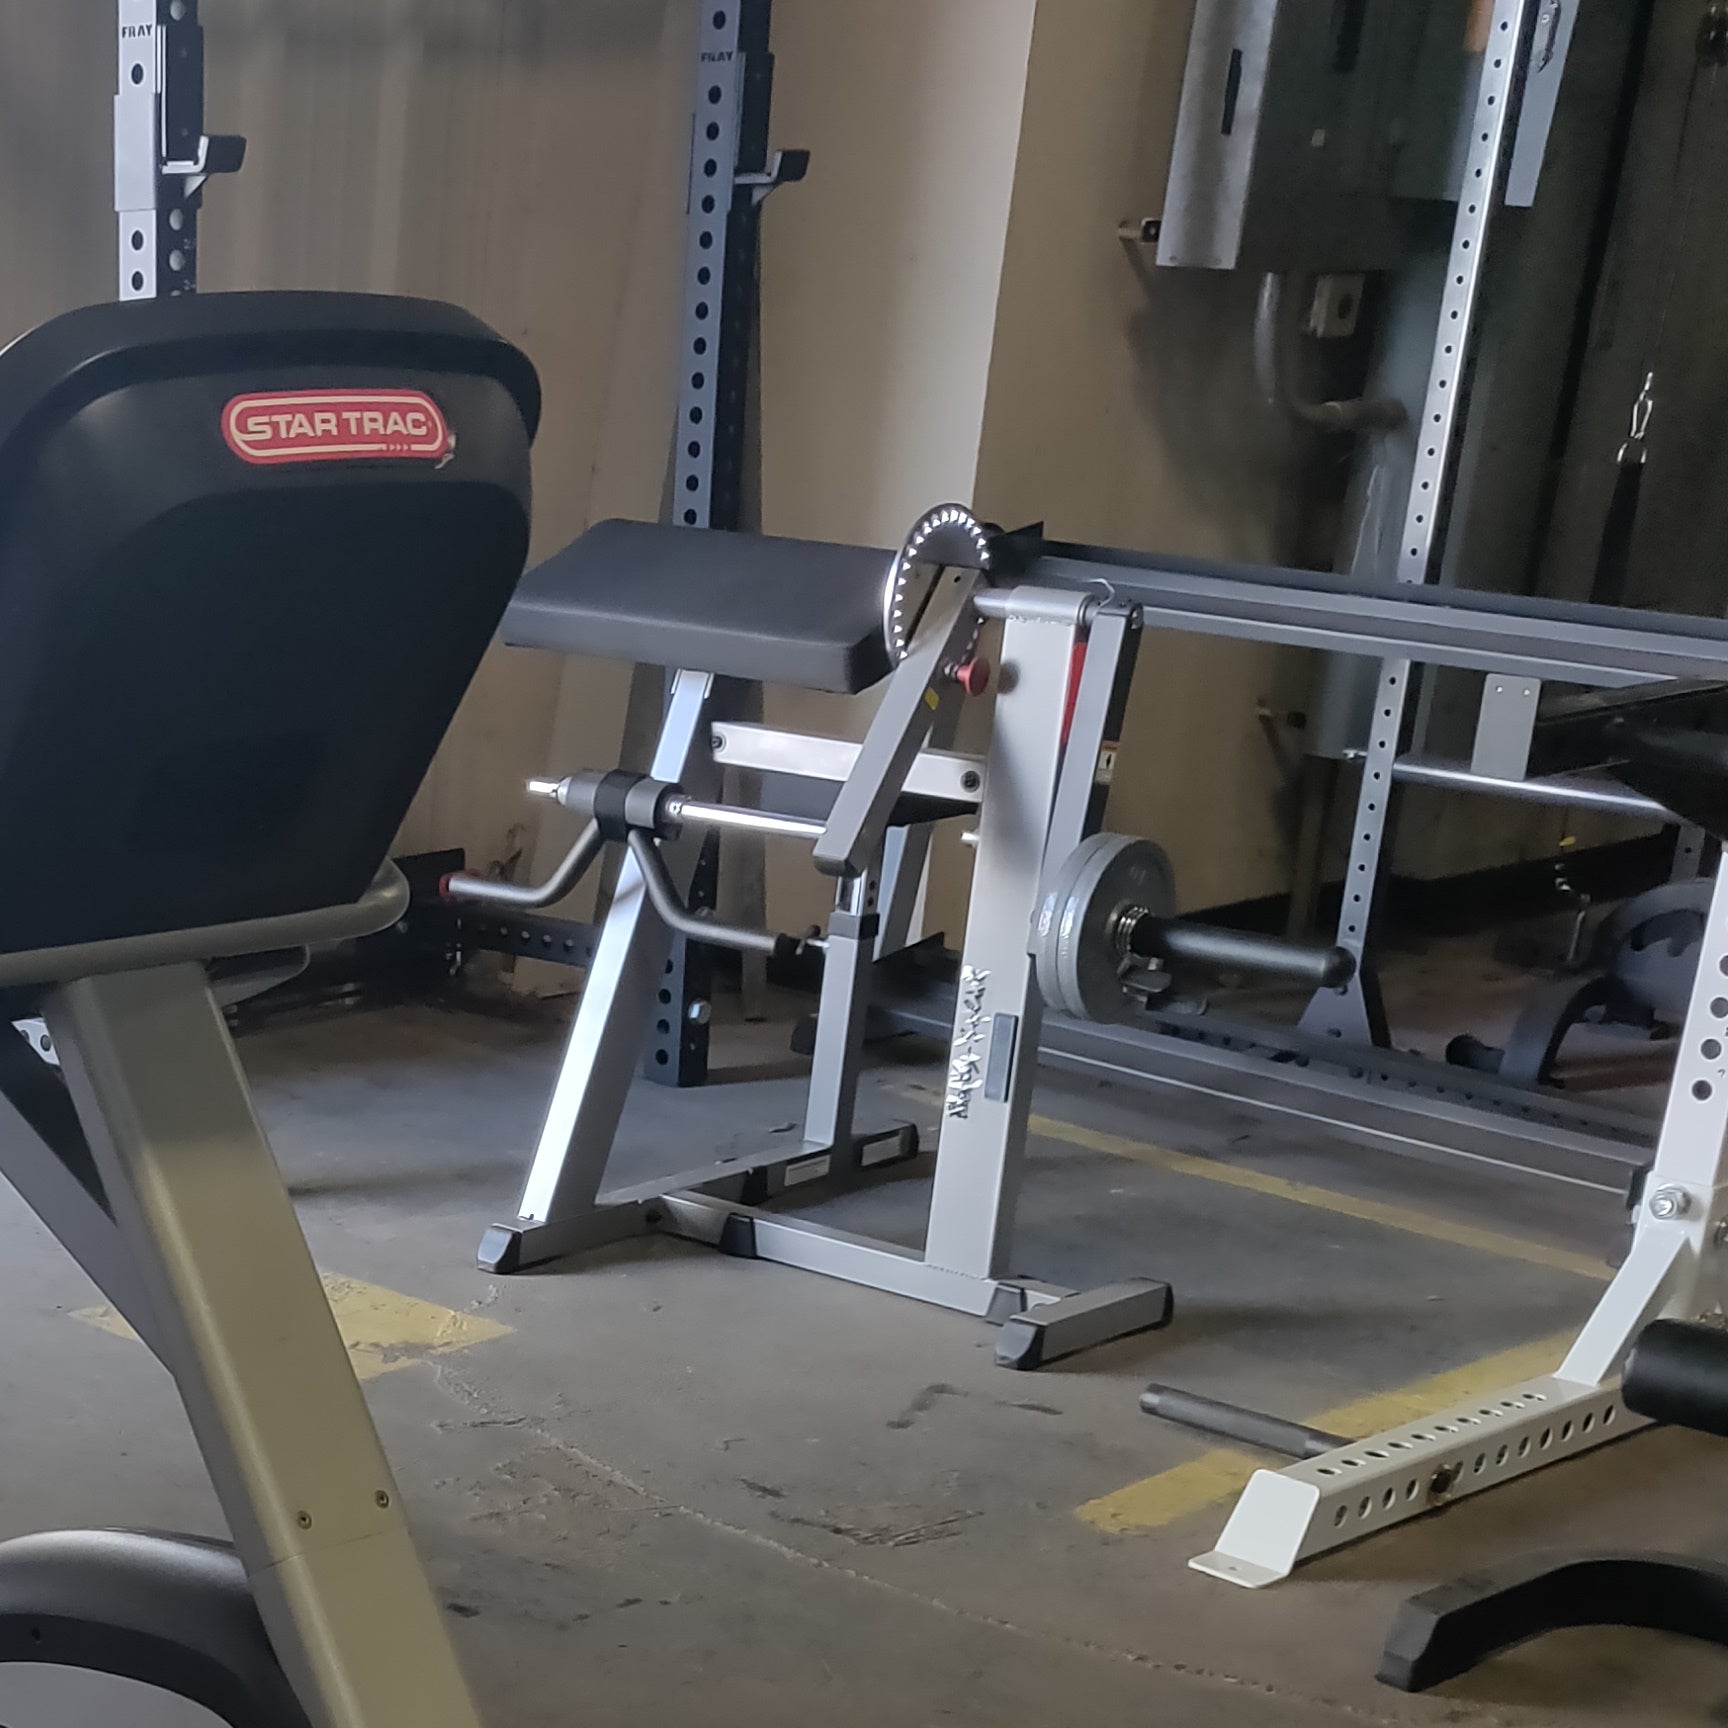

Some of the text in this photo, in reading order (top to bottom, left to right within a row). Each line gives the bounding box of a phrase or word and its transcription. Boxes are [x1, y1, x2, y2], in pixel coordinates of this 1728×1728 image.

[121, 24, 153, 39] FRAY
[240, 411, 427, 441] STAR TRAC
